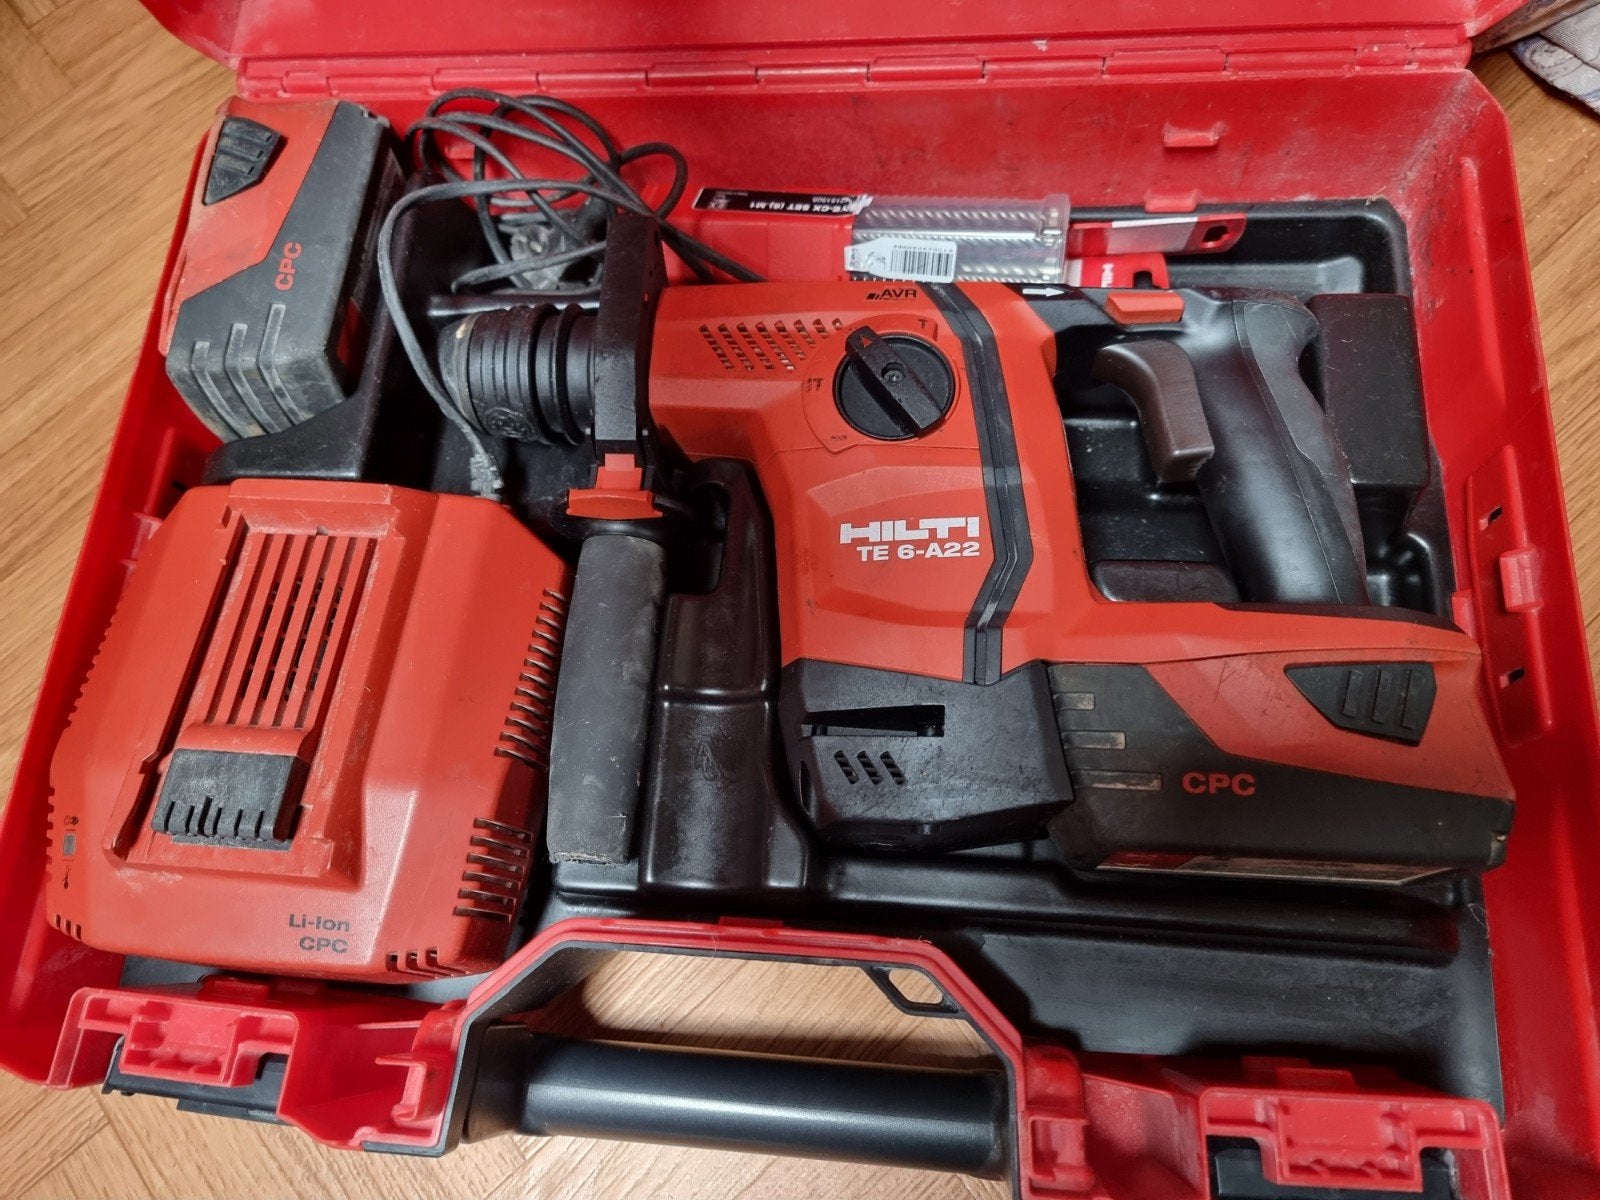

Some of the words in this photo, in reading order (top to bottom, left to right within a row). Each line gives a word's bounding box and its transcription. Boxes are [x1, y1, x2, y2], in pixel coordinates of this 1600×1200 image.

[786, 202, 811, 212] SET
[275, 242, 302, 291] CPC
[1101, 263, 1114, 288] HIL
[880, 288, 917, 299] AVR
[840, 516, 980, 544] HILTI
[856, 545, 889, 562] TE
[897, 541, 980, 560] 6-A22
[1182, 772, 1256, 796] CPC
[289, 913, 350, 932] Li-Ion
[299, 936, 348, 954] CPC
